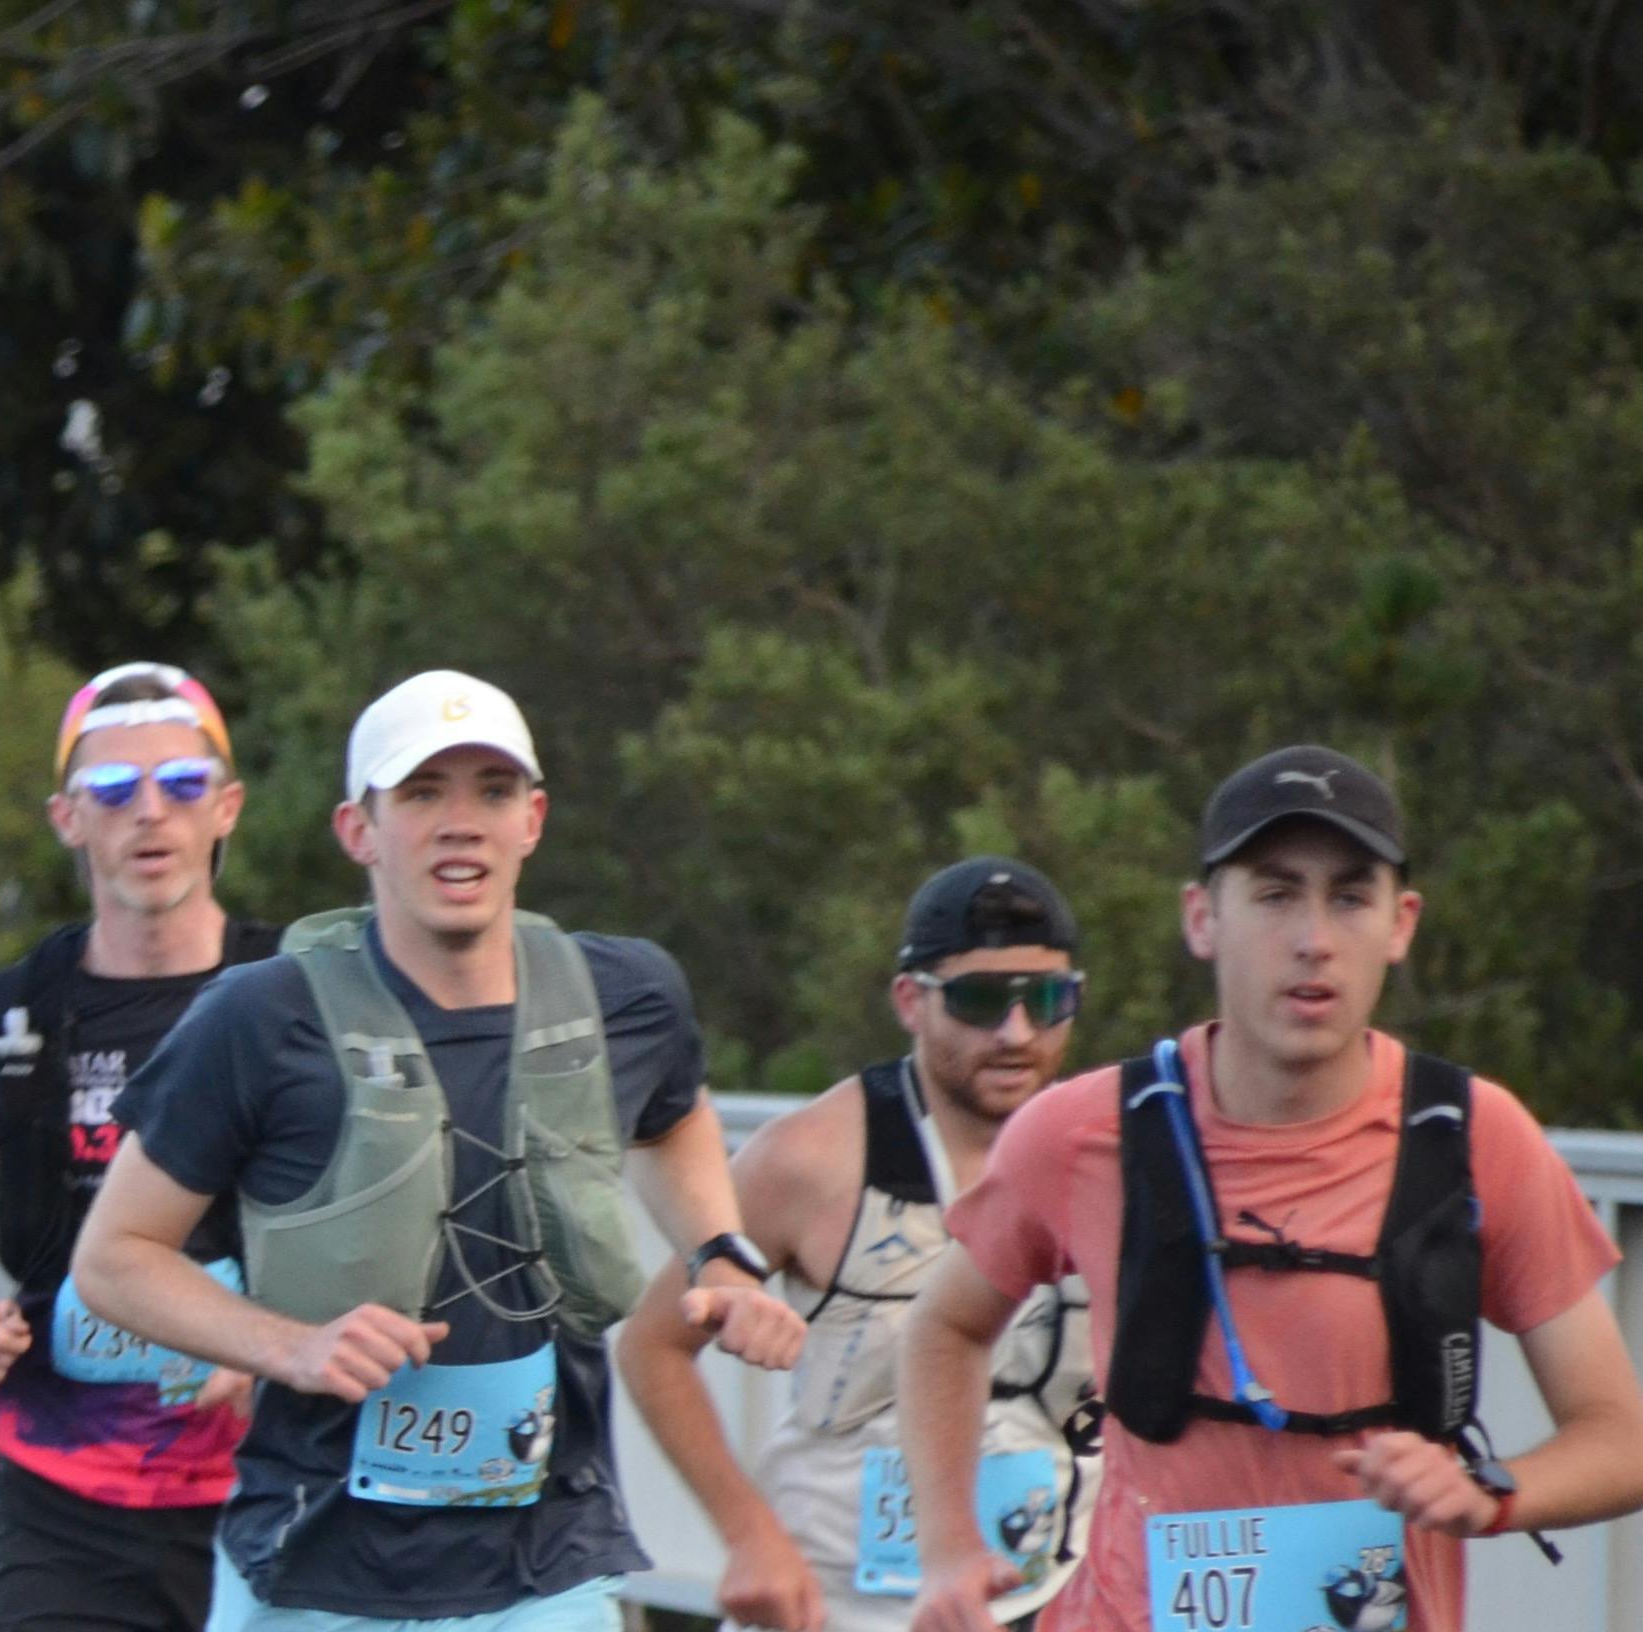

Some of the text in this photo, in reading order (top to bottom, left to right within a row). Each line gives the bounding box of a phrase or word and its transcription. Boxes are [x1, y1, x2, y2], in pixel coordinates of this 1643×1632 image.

[376, 1399, 474, 1455] 1249
[877, 1493, 916, 1541] 55
[1166, 1516, 1268, 1560] FULLIE
[1171, 1566, 1259, 1631] 407
